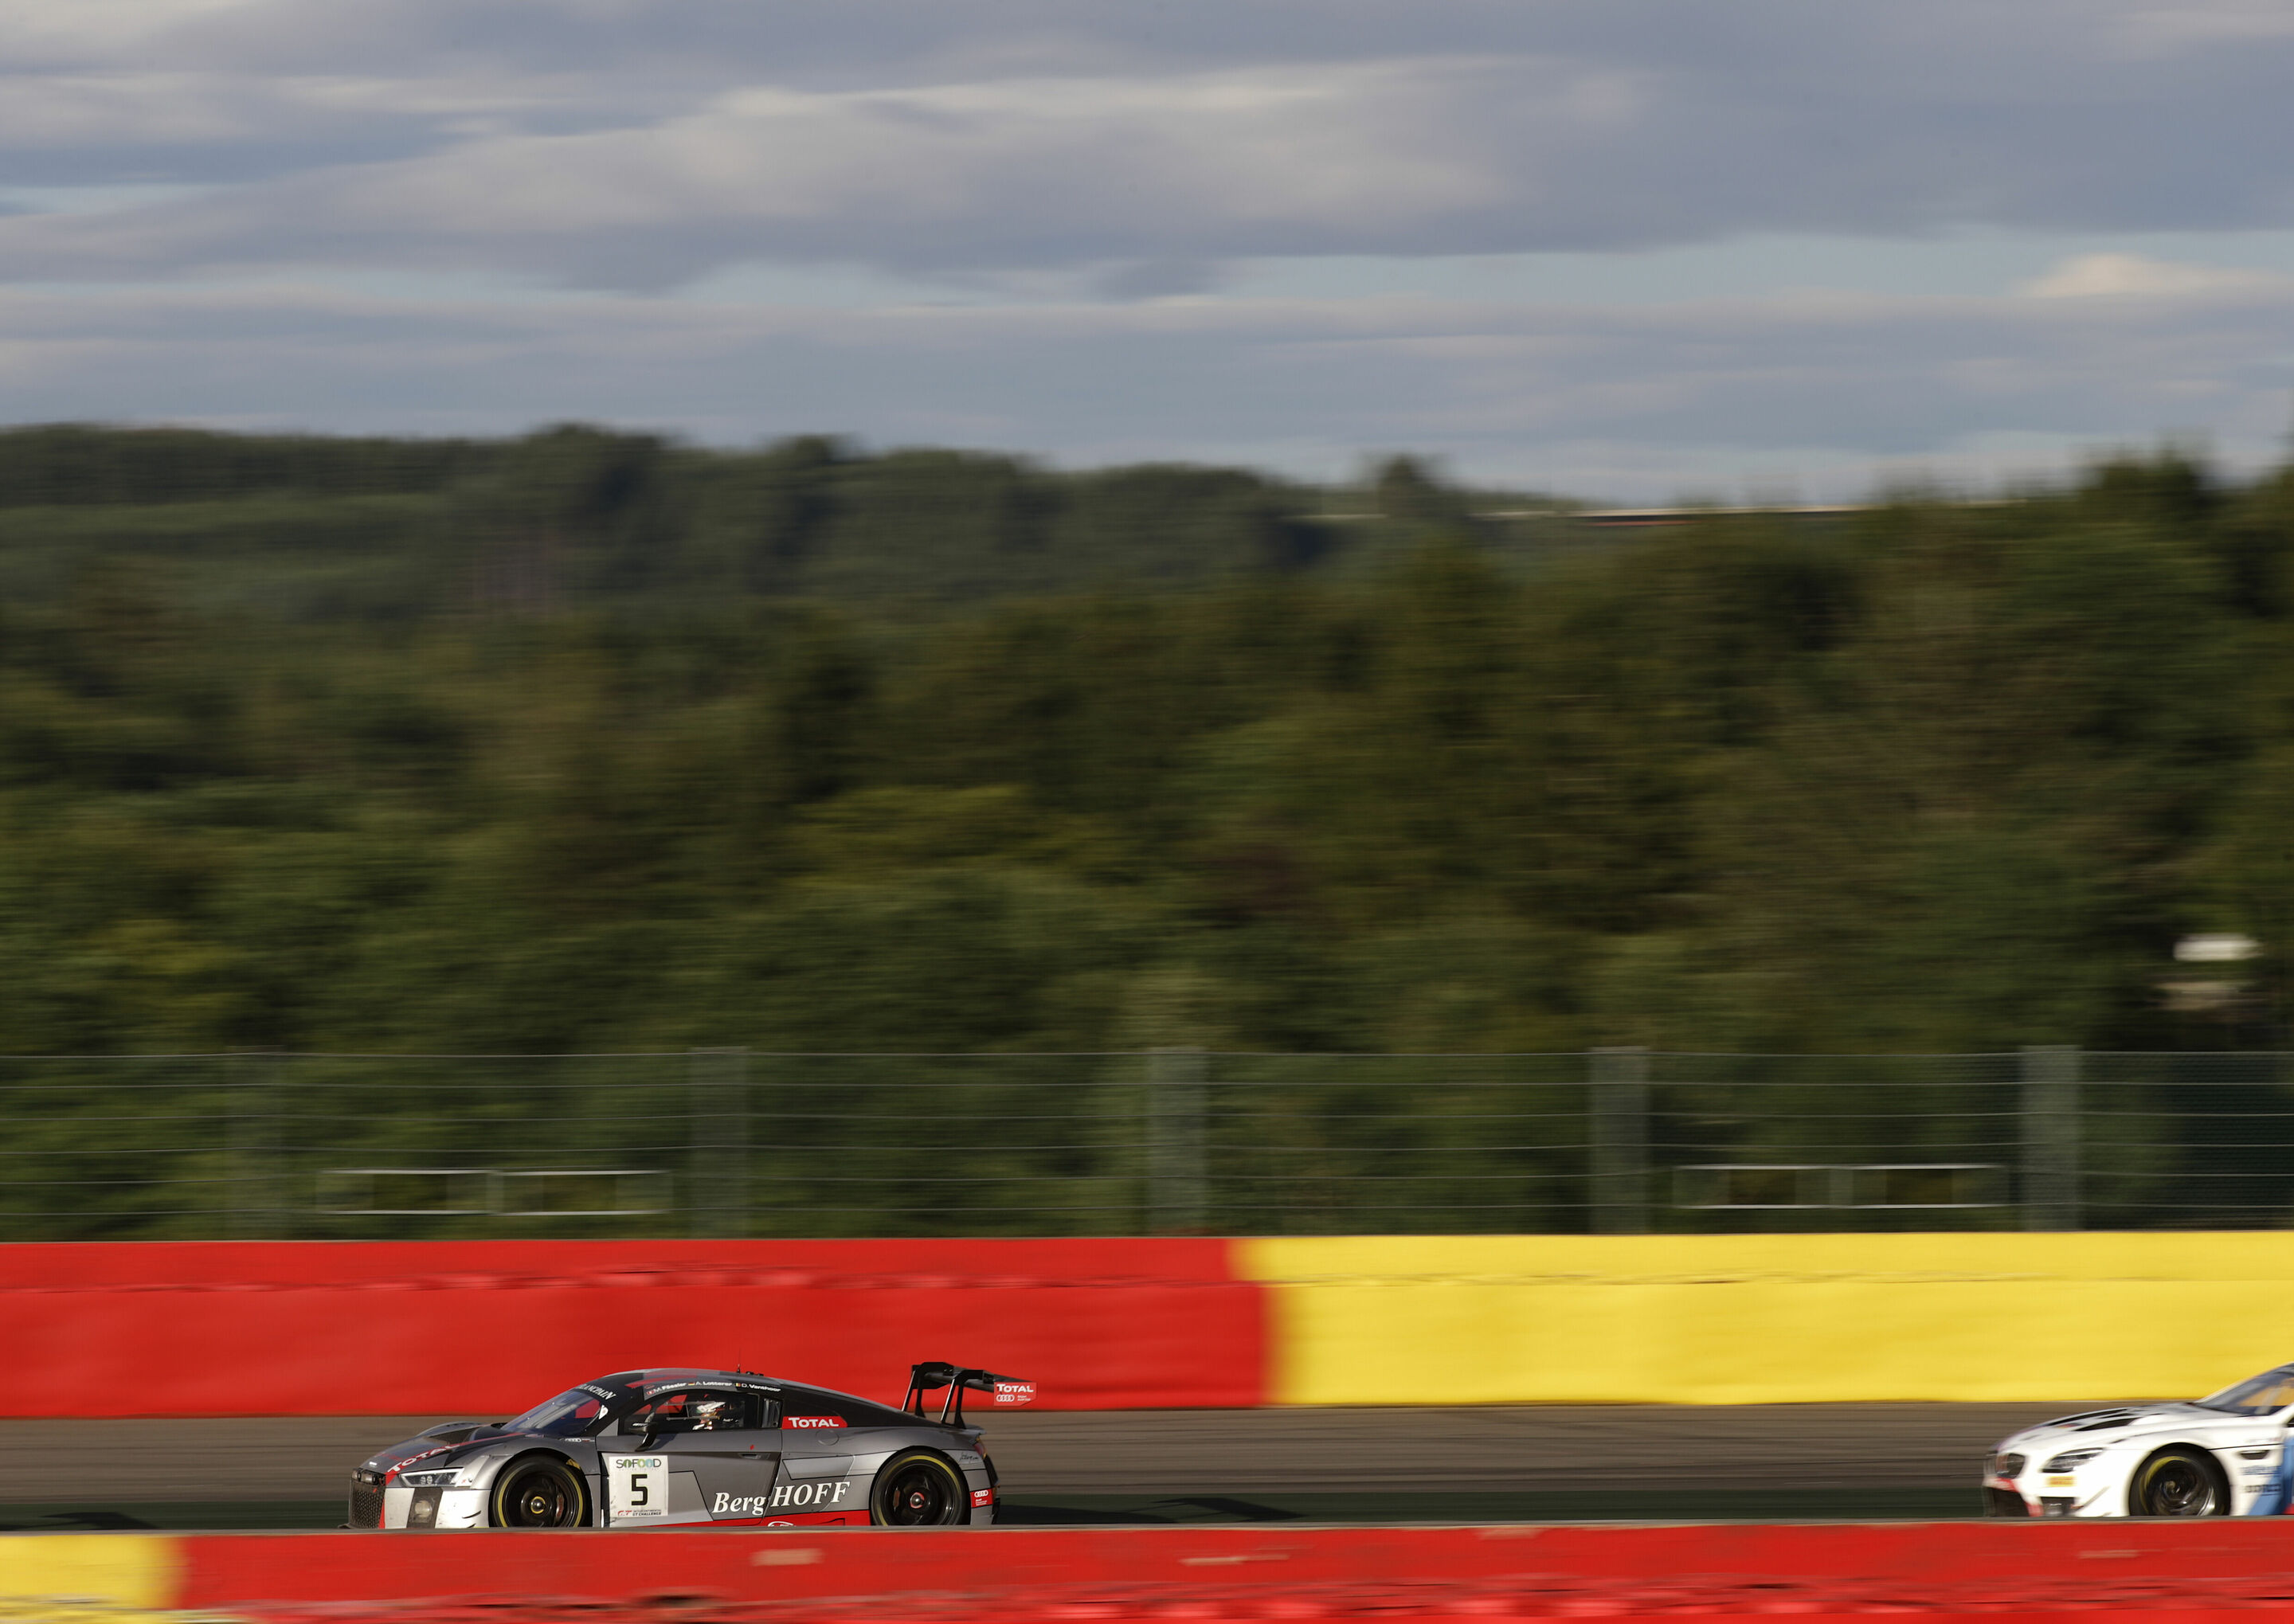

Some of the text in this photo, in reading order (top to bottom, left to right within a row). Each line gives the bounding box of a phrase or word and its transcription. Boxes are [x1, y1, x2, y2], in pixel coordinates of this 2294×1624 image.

[996, 1383, 1035, 1393] TOTAL
[788, 1417, 840, 1428] TOTAL
[387, 1445, 460, 1473] TOTAL
[631, 1473, 648, 1506] 5
